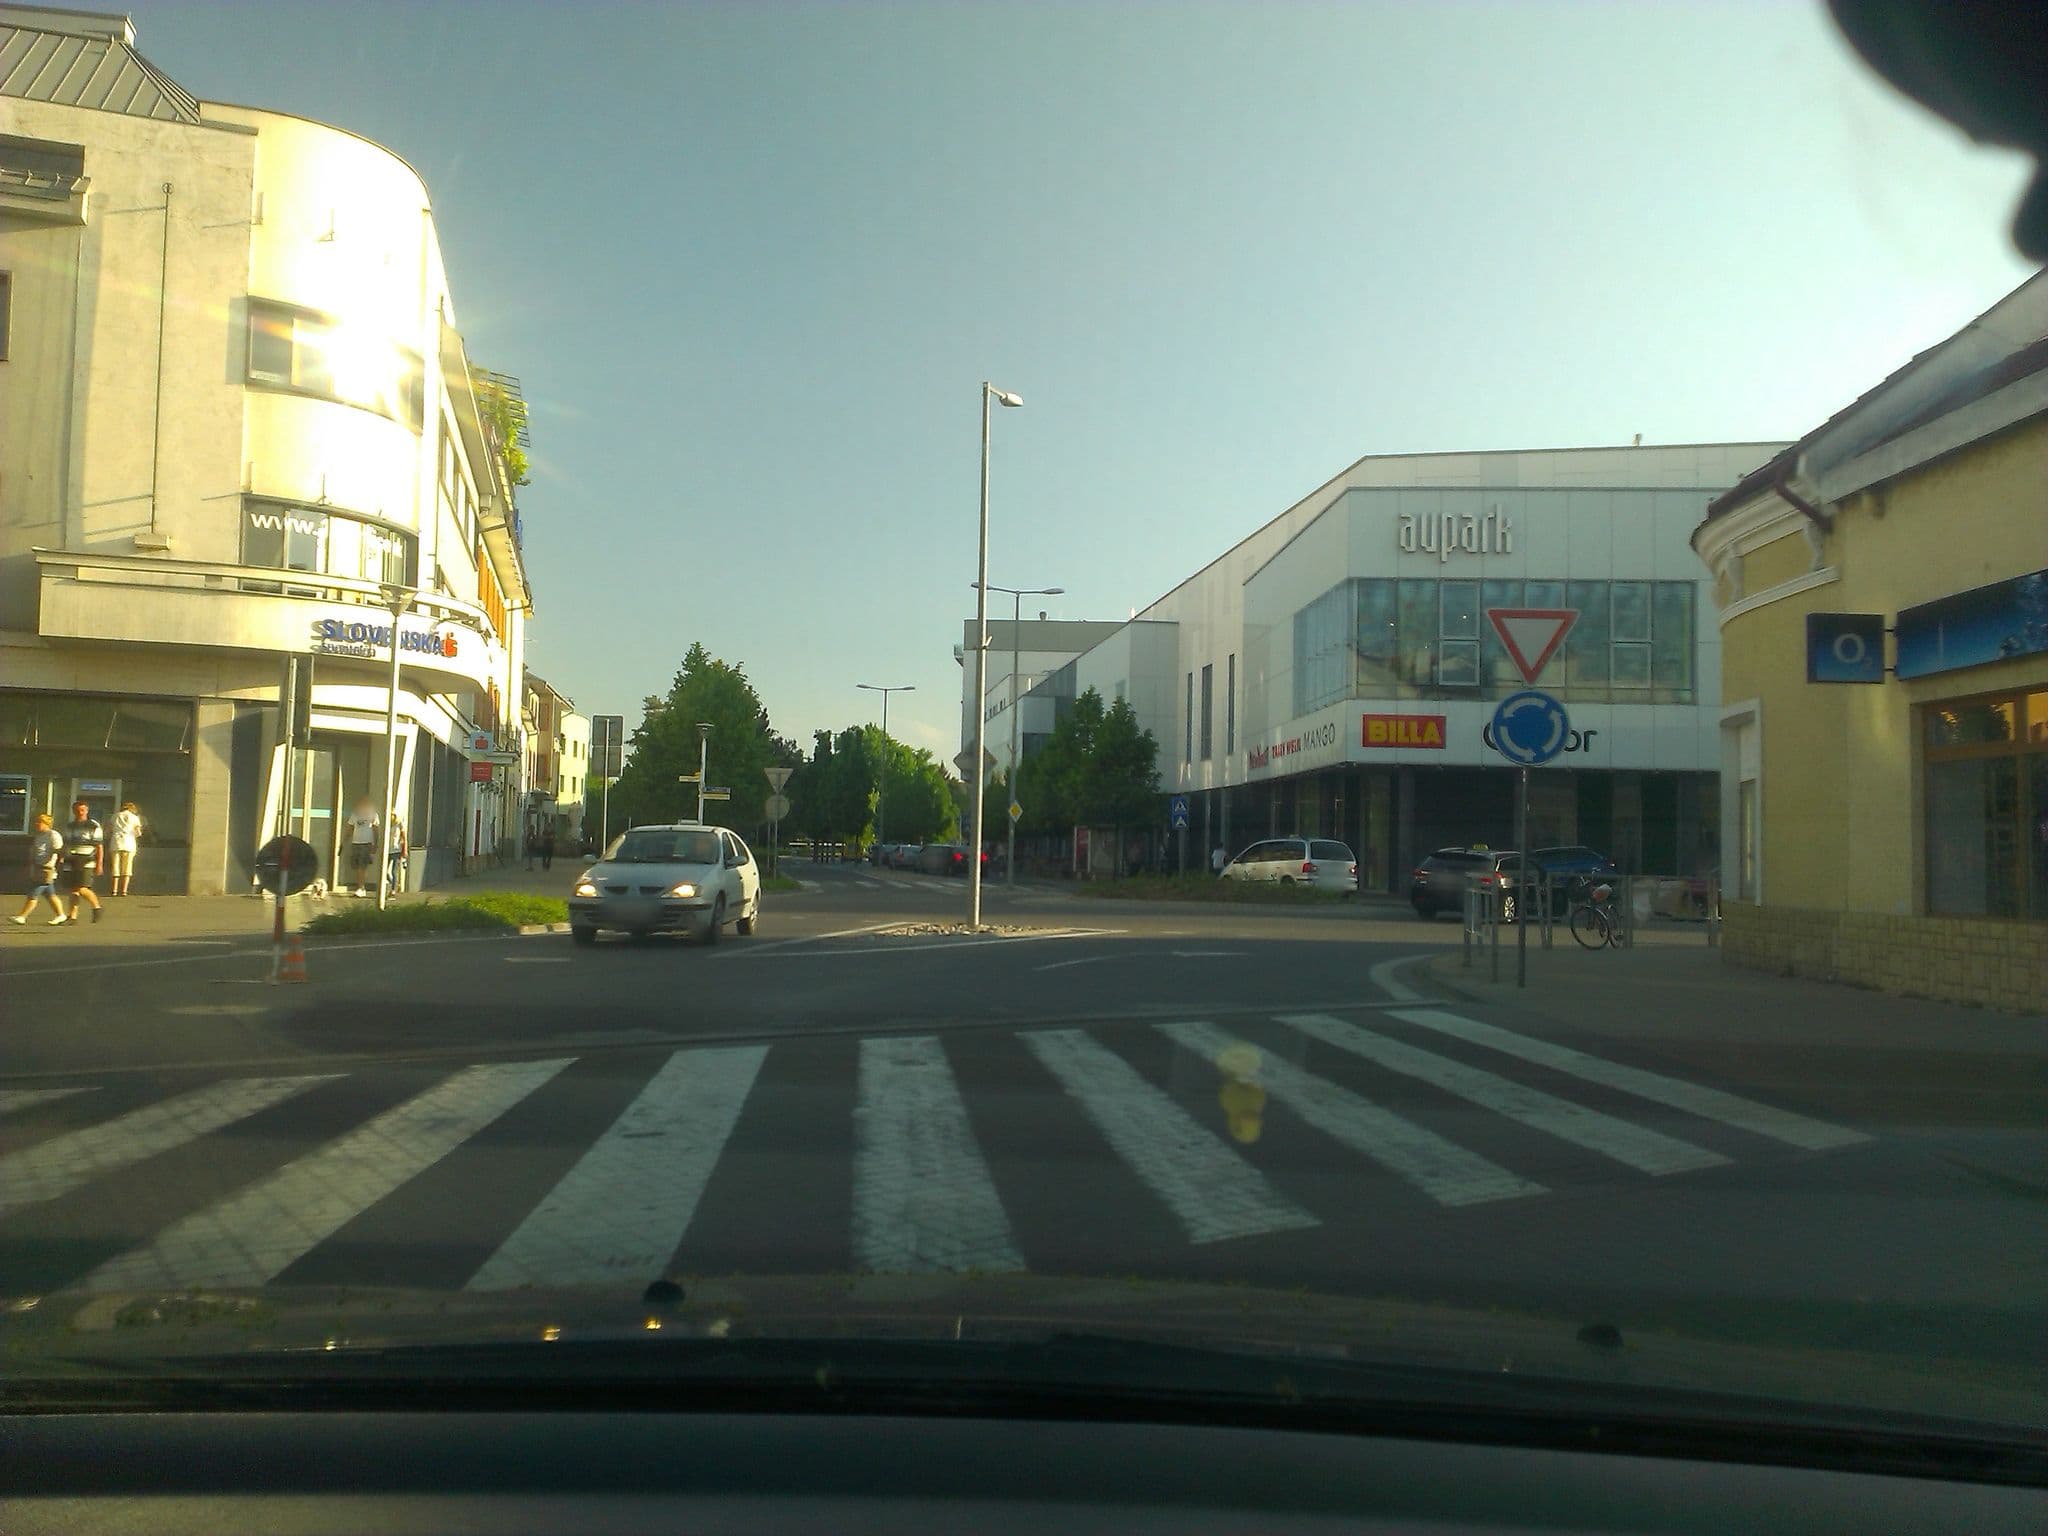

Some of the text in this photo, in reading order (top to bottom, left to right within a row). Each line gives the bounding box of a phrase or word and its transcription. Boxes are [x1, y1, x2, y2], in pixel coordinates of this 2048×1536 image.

[1399, 503, 1513, 563] aupark
[1303, 721, 1336, 752] MANGO
[1367, 719, 1442, 744] BILLA
